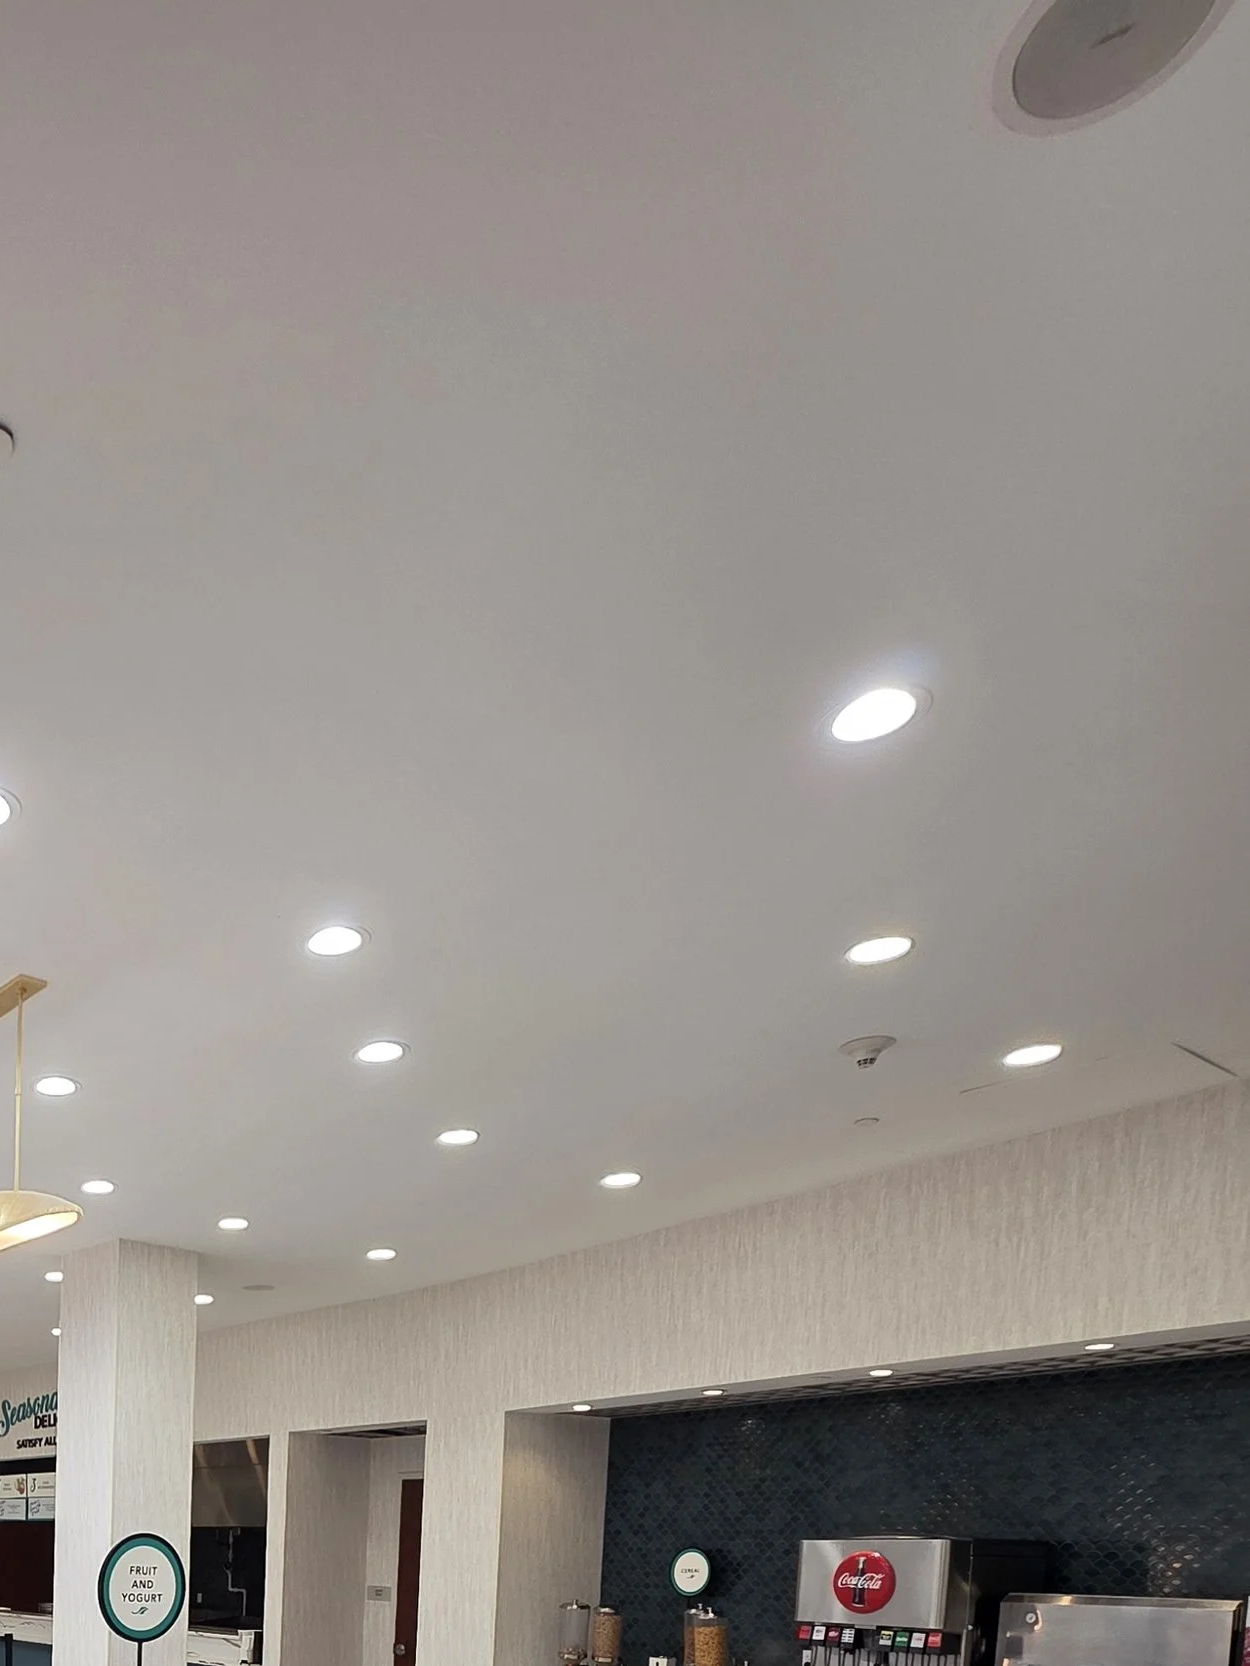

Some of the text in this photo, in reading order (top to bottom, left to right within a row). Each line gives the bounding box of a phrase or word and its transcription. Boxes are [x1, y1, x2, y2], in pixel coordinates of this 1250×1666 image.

[34, 1414, 58, 1429] DELI
[16, 1438, 43, 1449] SATISFY
[129, 1565, 158, 1576] FRUIT
[131, 1580, 154, 1589] AND
[121, 1593, 163, 1603] YOGURT
